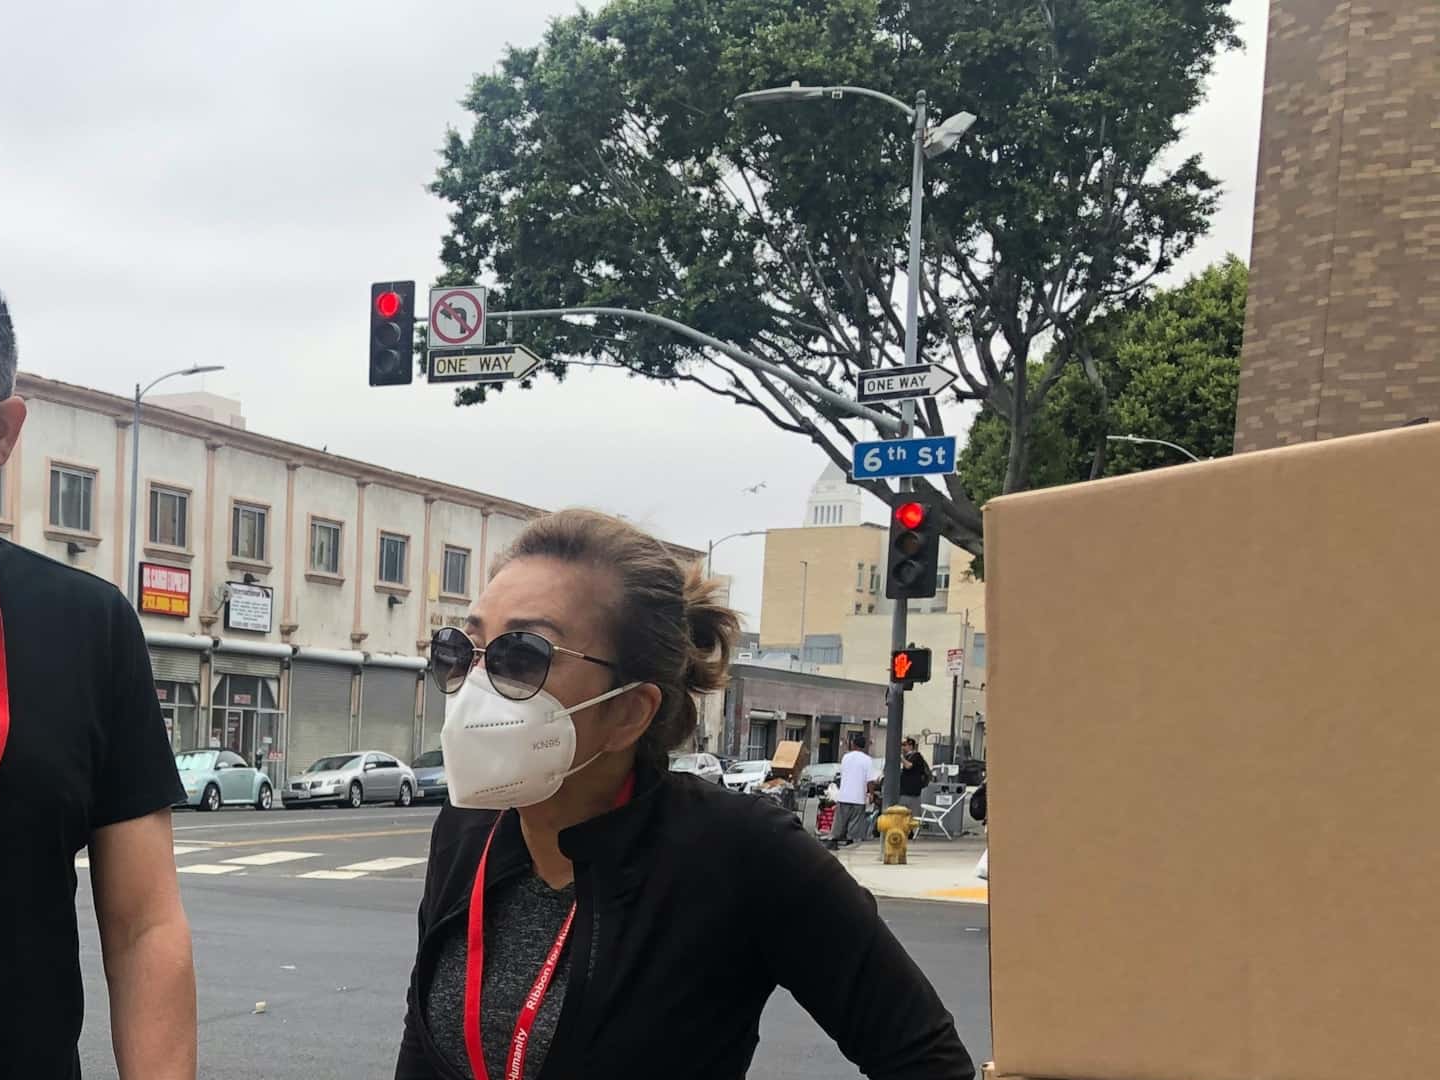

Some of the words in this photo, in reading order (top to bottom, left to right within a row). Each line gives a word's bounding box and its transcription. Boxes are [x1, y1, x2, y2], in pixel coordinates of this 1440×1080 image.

[436, 359, 468, 374] ONE
[480, 355, 513, 372] WAY
[867, 379, 894, 393] ONE
[899, 375, 927, 390] WAY
[863, 446, 907, 473] 6th
[917, 446, 946, 467] St
[526, 967, 552, 1010] Ribbon
